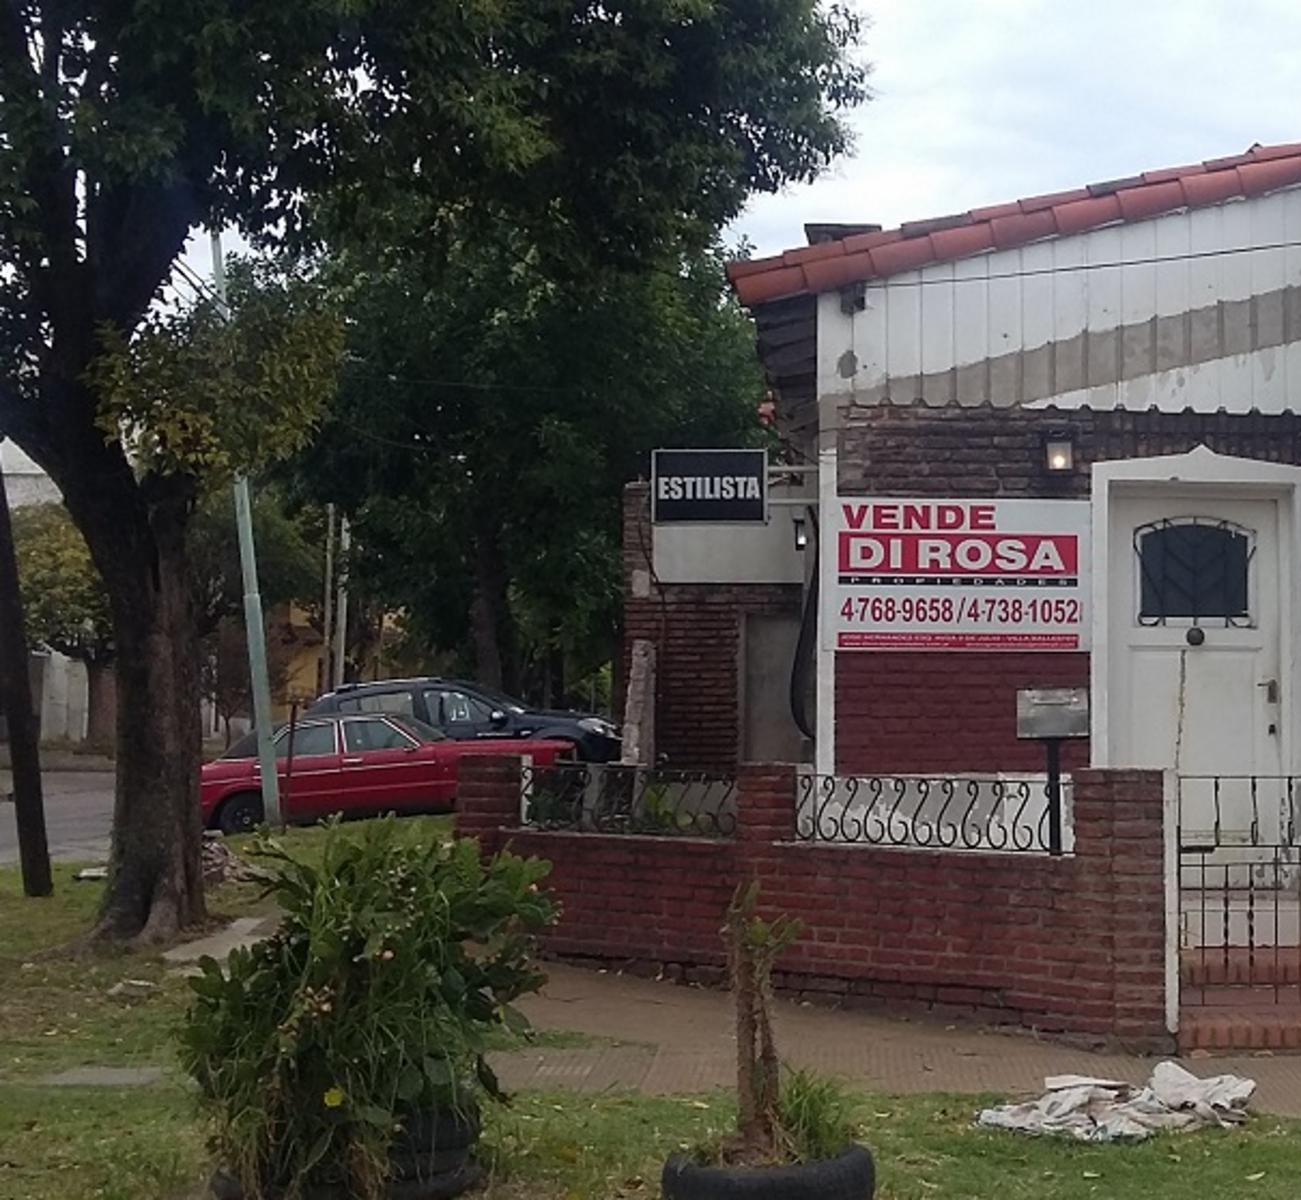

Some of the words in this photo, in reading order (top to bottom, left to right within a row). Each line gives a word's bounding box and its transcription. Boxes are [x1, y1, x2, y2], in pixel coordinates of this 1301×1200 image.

[658, 477, 760, 500] ESTILISTA
[842, 505, 996, 530] VENDE
[849, 537, 902, 569] DI
[918, 538, 1065, 571] ROSA
[851, 577, 1068, 587] PROPIEDADES
